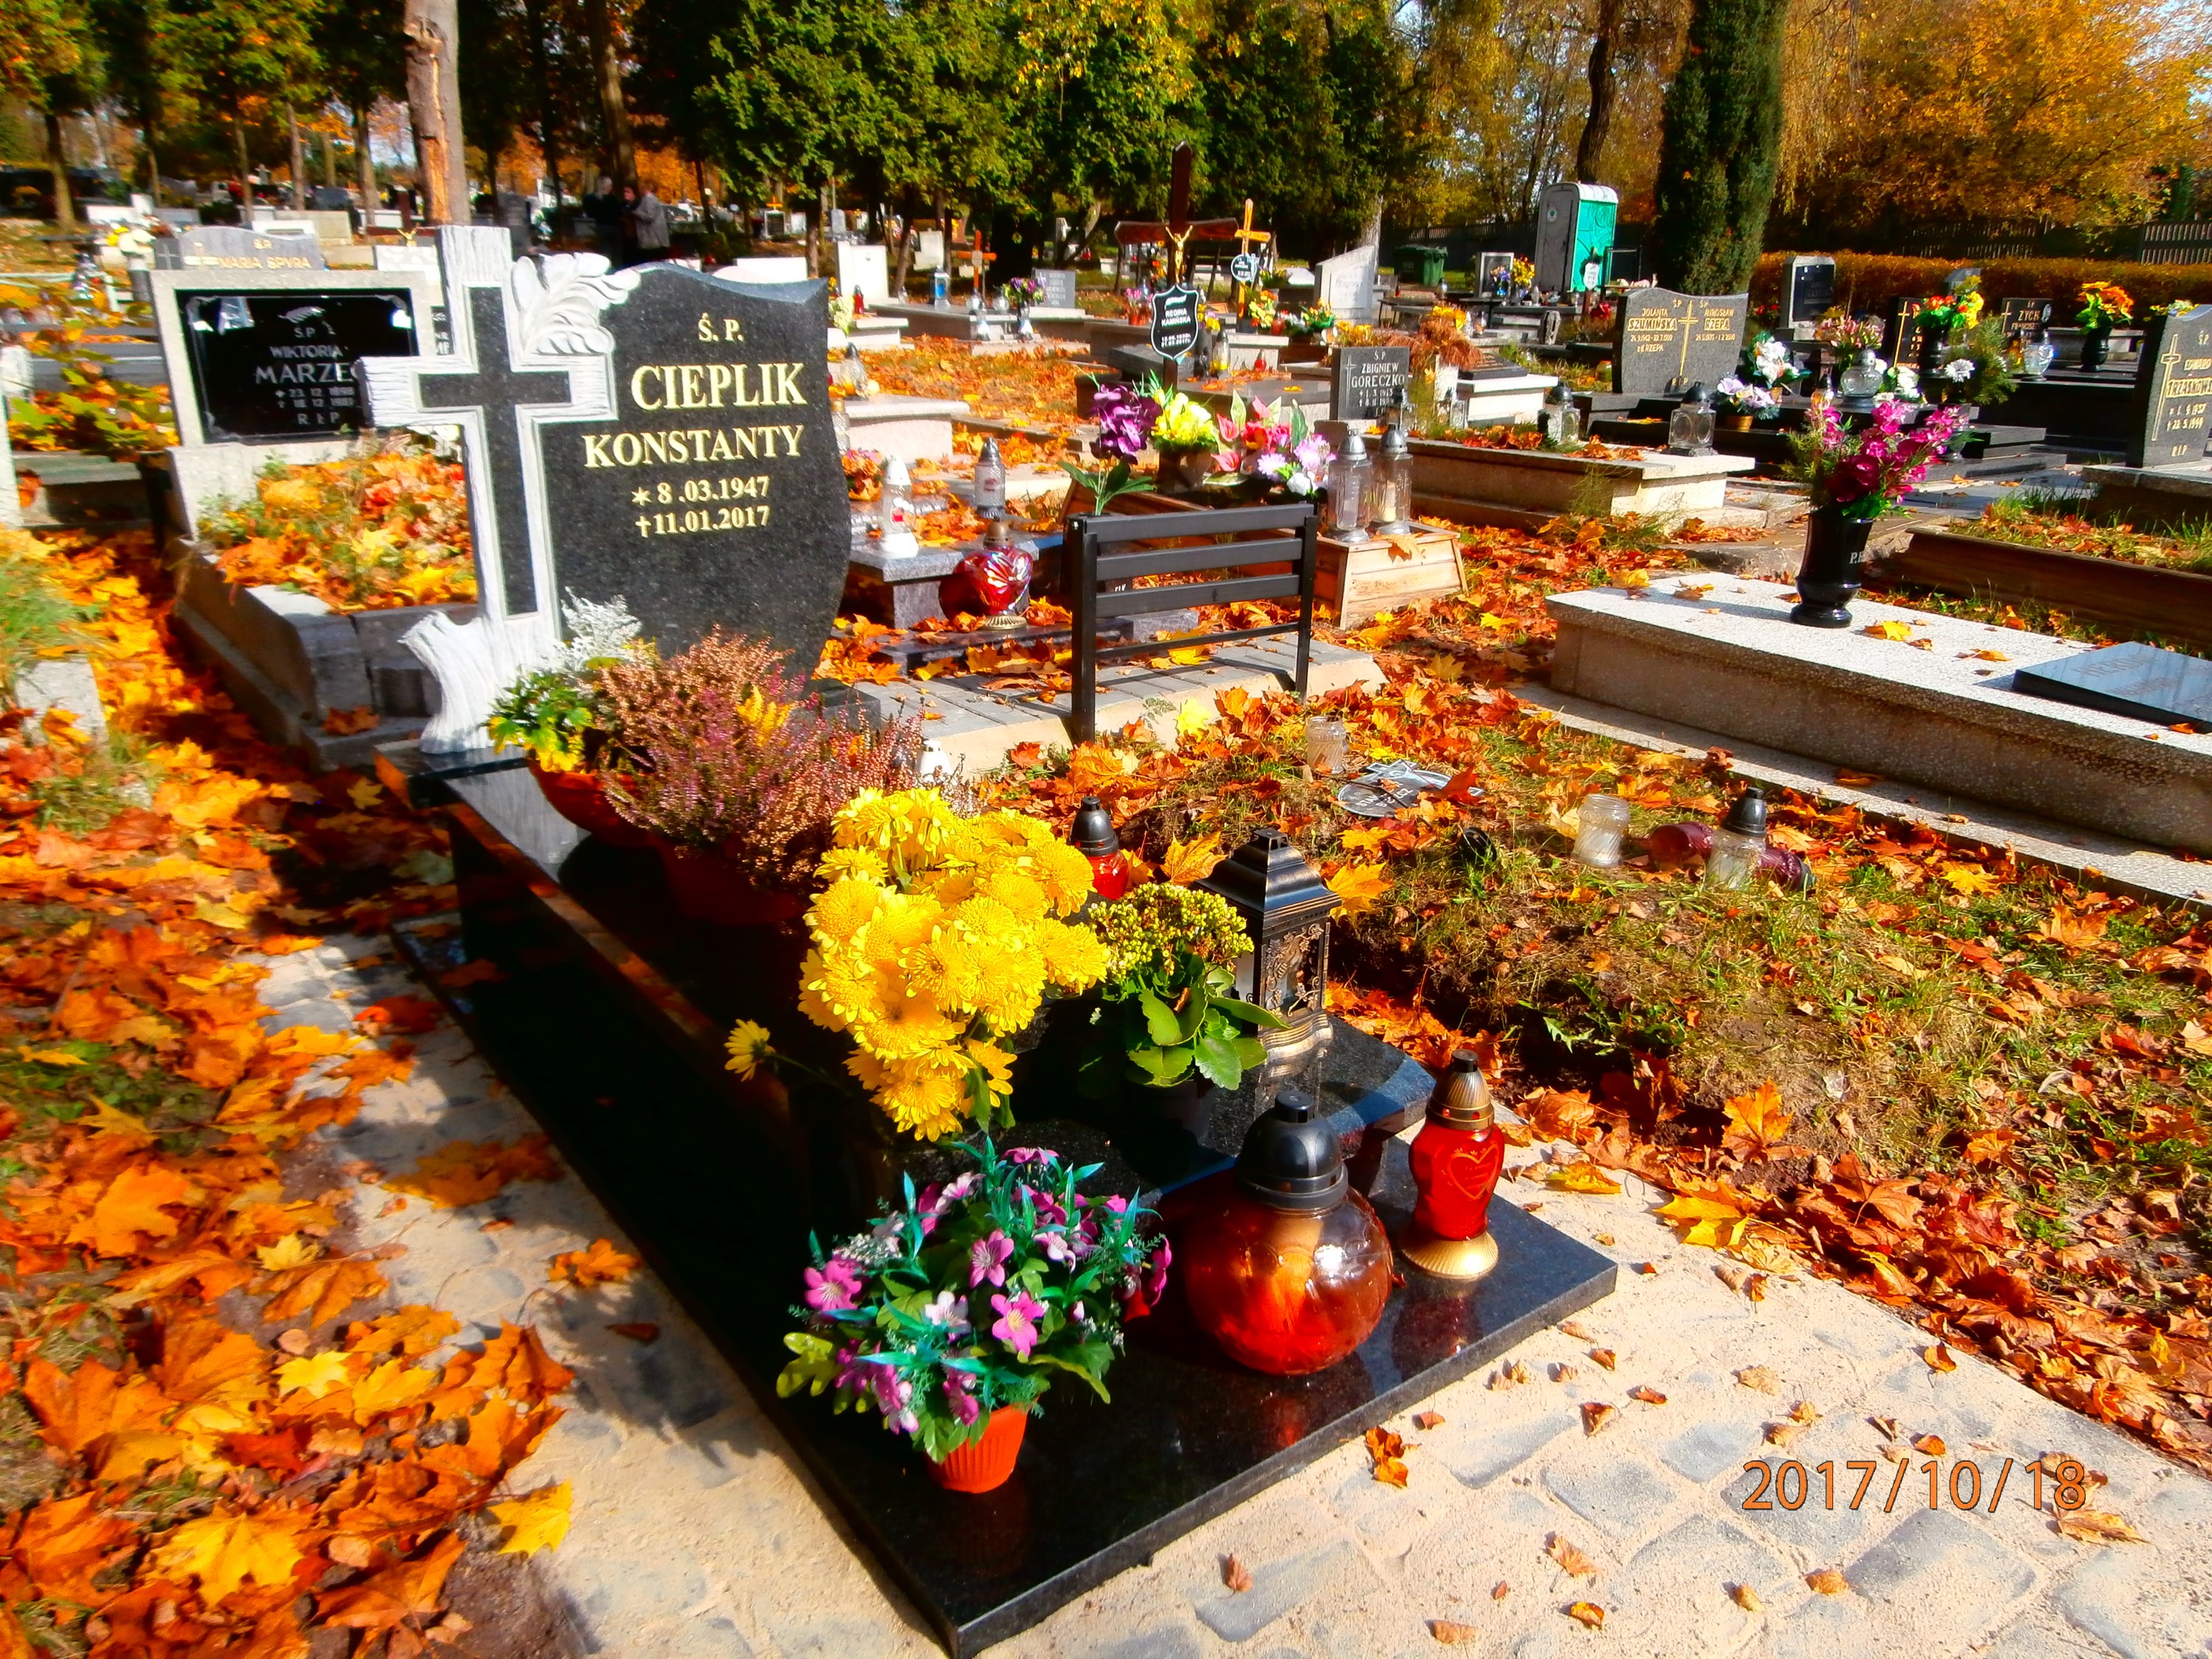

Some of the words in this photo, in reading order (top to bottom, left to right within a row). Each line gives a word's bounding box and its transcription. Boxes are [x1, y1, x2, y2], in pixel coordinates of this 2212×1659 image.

[1165, 307, 1188, 318] REGINA
[2018, 310, 2040, 321] ZYCH
[270, 345, 344, 359] WIKTORIA
[1361, 362, 1400, 374] ZBIGNIEW
[631, 362, 808, 411] CIEPLIK
[581, 424, 804, 469] KONSTANTY
